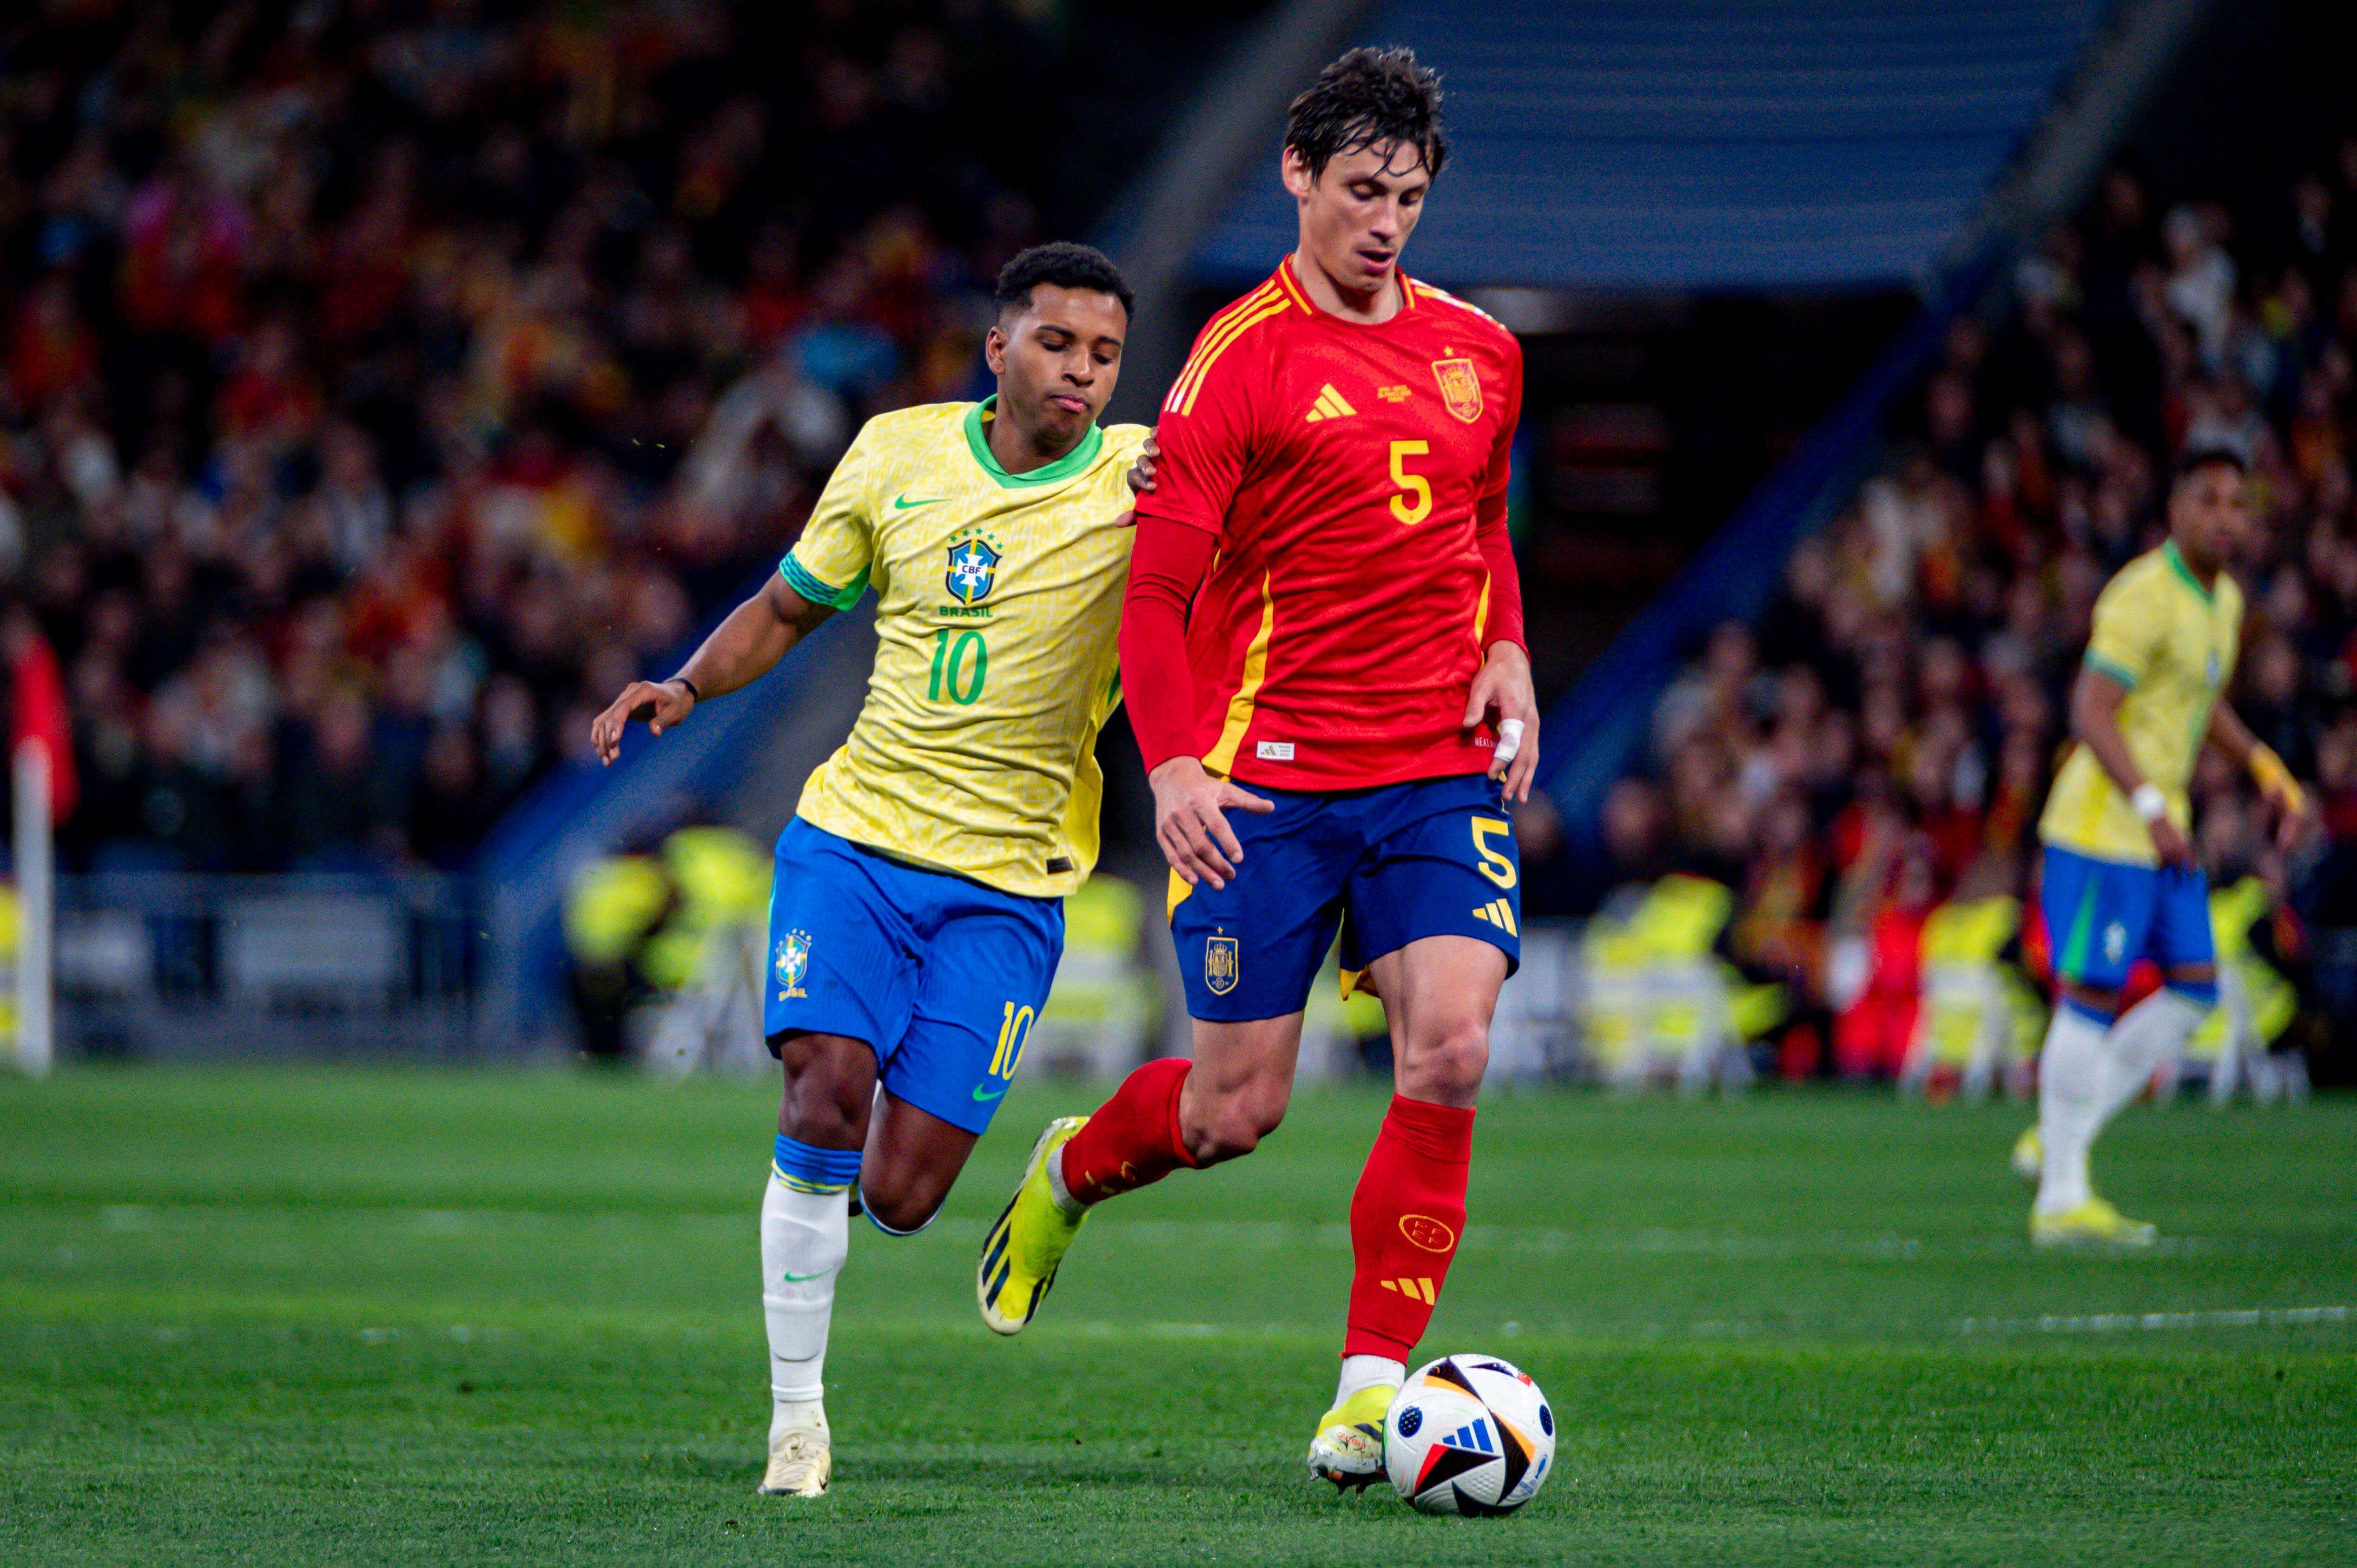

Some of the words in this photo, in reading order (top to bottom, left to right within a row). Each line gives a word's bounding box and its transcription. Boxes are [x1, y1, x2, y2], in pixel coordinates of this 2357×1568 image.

[1390, 440, 1432, 525] 5
[962, 565, 982, 574] CBF
[939, 605, 993, 618] BRASIL
[929, 629, 987, 705] 10
[1471, 816, 1517, 889] 5
[988, 1001, 1034, 1080] 10
